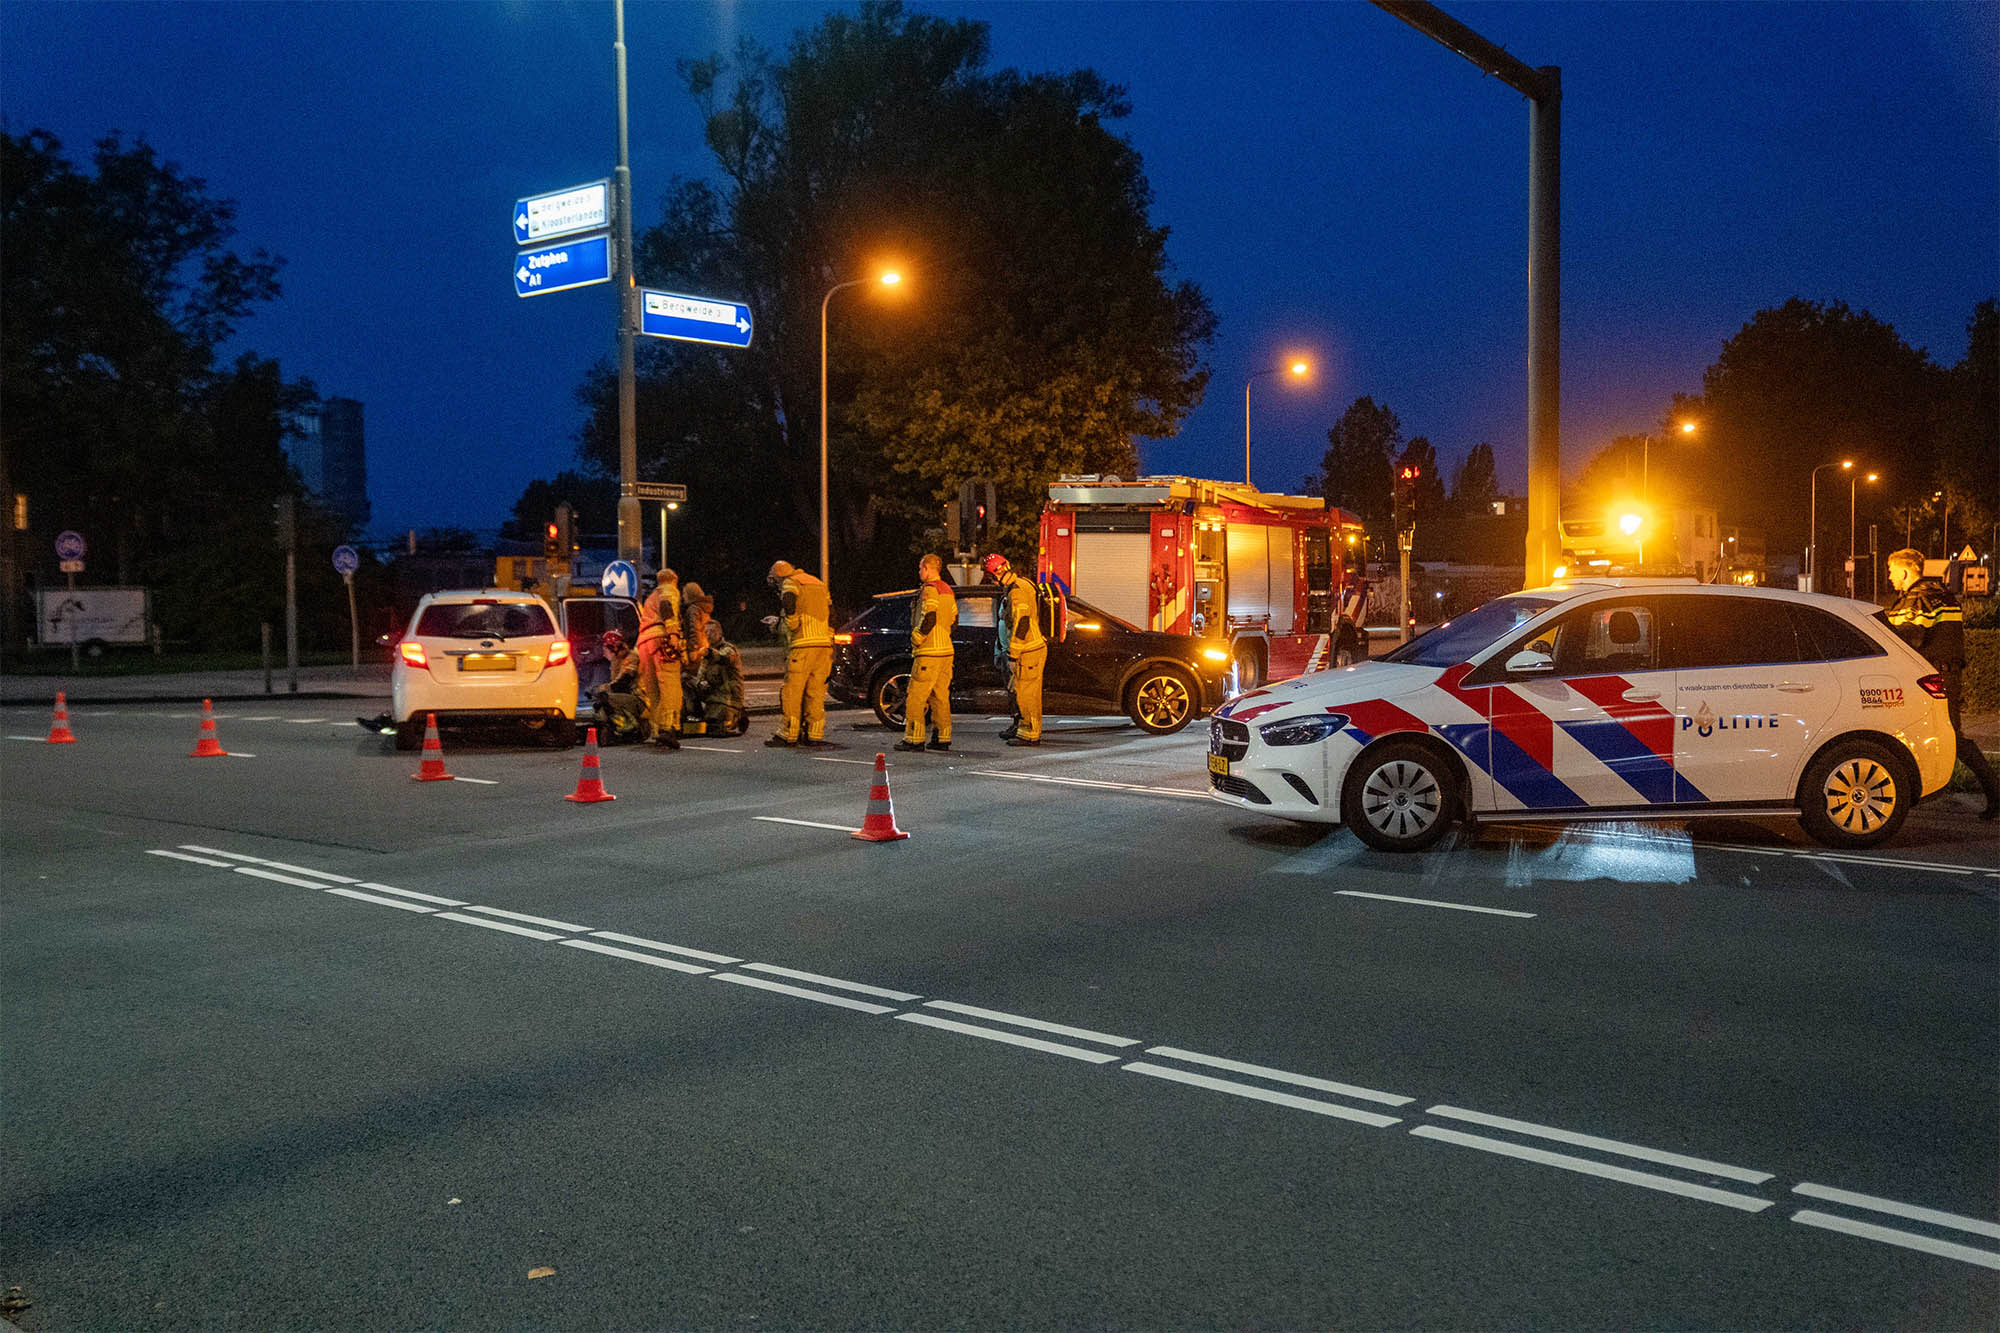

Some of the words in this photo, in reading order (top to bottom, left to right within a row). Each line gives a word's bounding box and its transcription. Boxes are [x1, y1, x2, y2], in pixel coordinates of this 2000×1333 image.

[541, 208, 603, 229] Kloosterlanden
[528, 252, 568, 269] Zutphen
[529, 273, 542, 287] A1
[662, 299, 713, 317] Bergweide
[1860, 689, 1881, 697] 0900
[1883, 688, 1903, 700] 112
